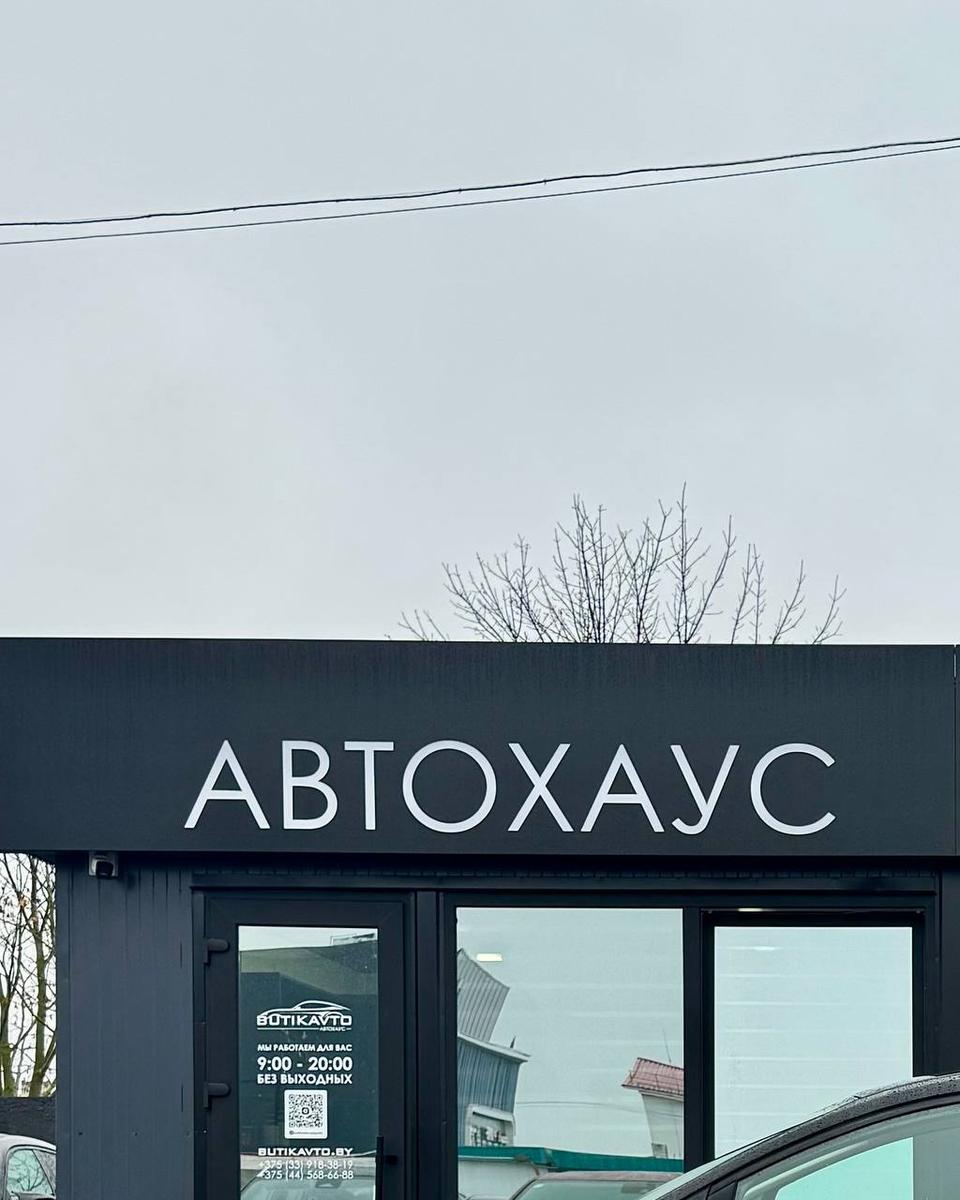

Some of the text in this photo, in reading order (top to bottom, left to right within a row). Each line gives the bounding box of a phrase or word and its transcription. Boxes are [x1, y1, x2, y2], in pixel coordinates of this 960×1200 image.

[184, 739, 836, 835] АВТОХАУС
[257, 1015, 352, 1026] BUTIKAVTO
[317, 1044, 334, 1052] ДЛЯ
[257, 1056, 292, 1071] 9:00
[307, 1056, 353, 1071] 20:00
[257, 1073, 353, 1085] БЕЗ ВЫХОДНЫХ
[258, 1147, 353, 1156] BUTIKAVTO.BY
[285, 1160, 304, 1170] (33)
[306, 1160, 353, 1169] 918-38-19
[285, 1170, 304, 1181] (44)
[306, 1170, 354, 1180] 568-66-88
